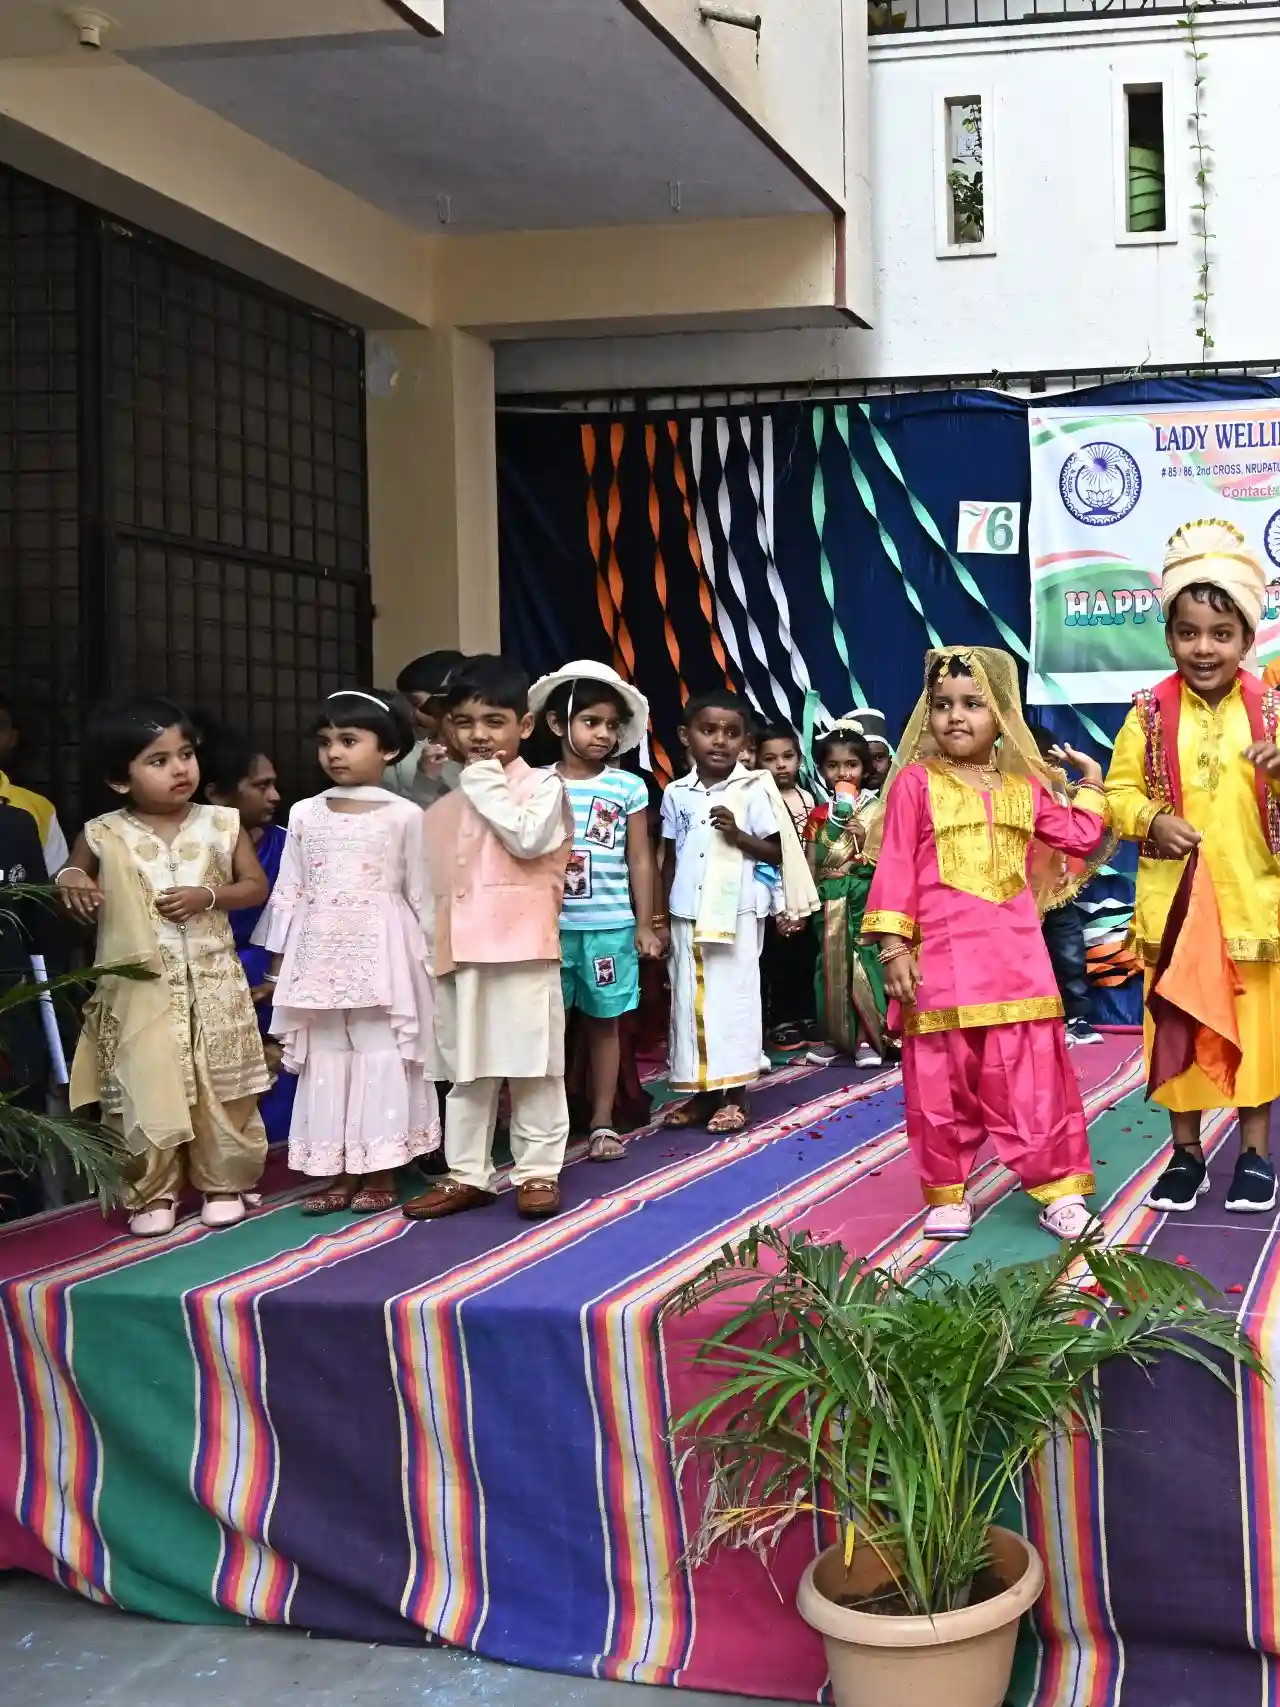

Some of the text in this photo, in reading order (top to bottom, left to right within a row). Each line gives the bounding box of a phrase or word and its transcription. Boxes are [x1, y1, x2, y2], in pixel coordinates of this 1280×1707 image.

[1155, 425, 1209, 452] LADY
[1196, 465, 1211, 476] 2nd
[1221, 485, 1276, 498] Contact:
[959, 503, 1014, 552] 76
[1064, 587, 1166, 626] HAPP
